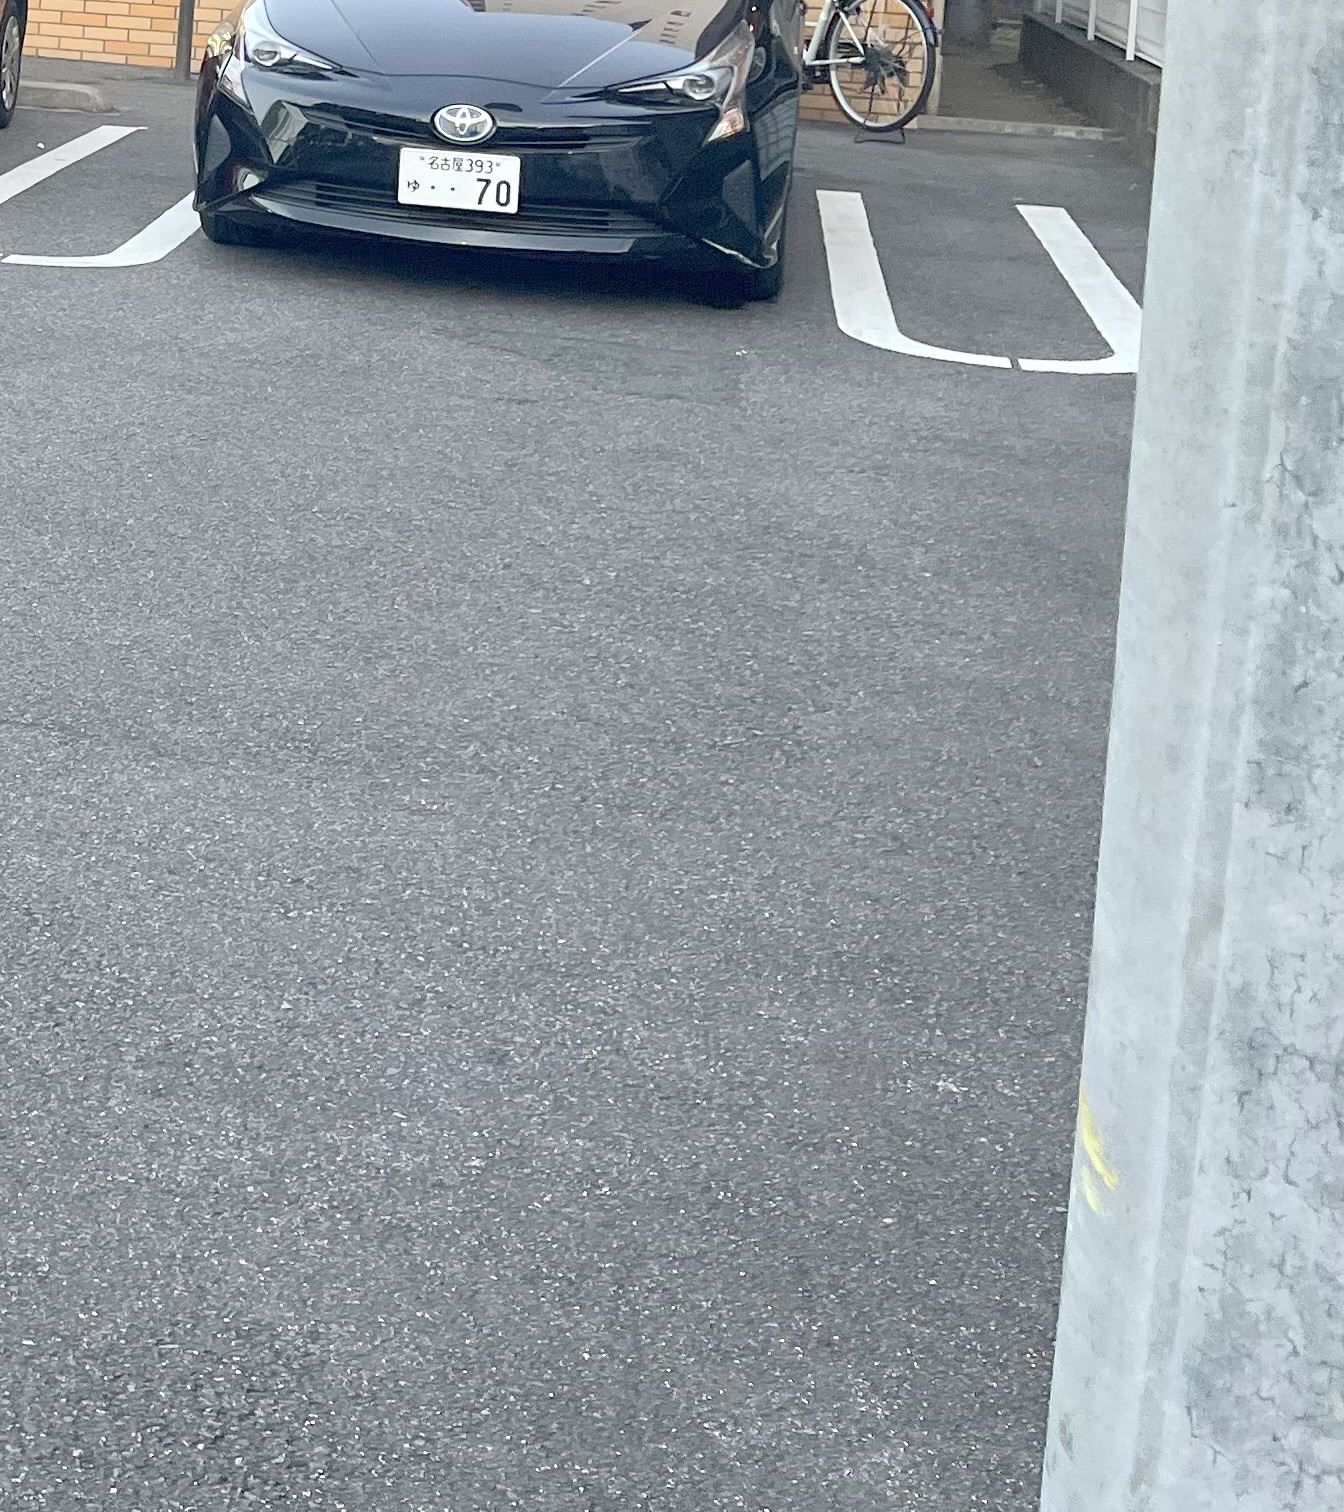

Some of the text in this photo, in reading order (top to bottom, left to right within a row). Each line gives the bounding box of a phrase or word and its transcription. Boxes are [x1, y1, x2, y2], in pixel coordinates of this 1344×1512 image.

[428, 156, 493, 174] 名古屋393
[407, 180, 420, 192] ゆ
